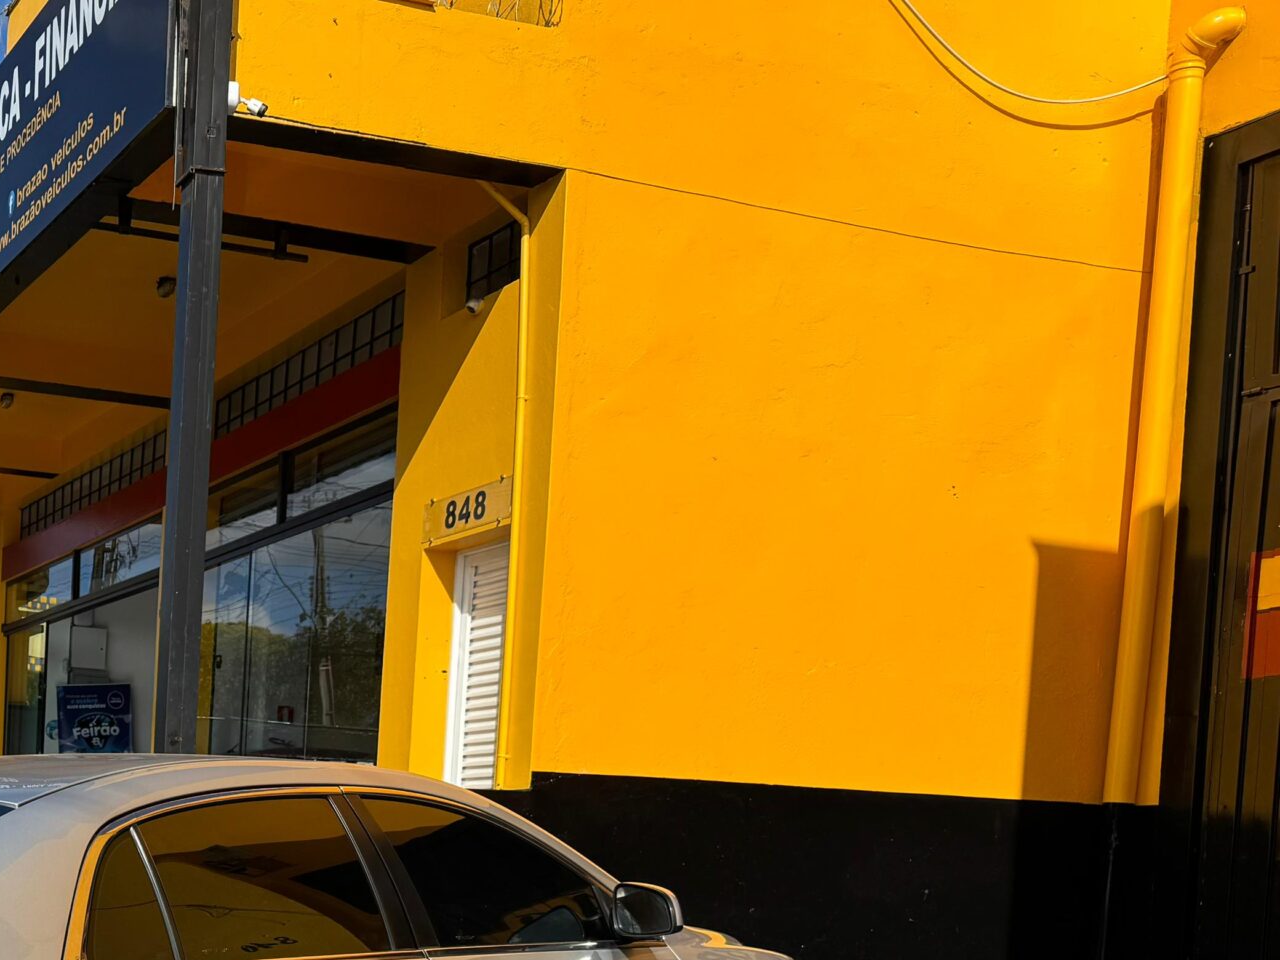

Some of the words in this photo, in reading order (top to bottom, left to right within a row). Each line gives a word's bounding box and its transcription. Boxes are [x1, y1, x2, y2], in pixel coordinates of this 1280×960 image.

[0, 156, 5, 174] E
[6, 90, 61, 166] PROCEDÊNCIA
[16, 163, 48, 208] brazao
[50, 111, 94, 172] veículos
[444, 490, 486, 529] 848
[72, 722, 120, 740] Feirão
